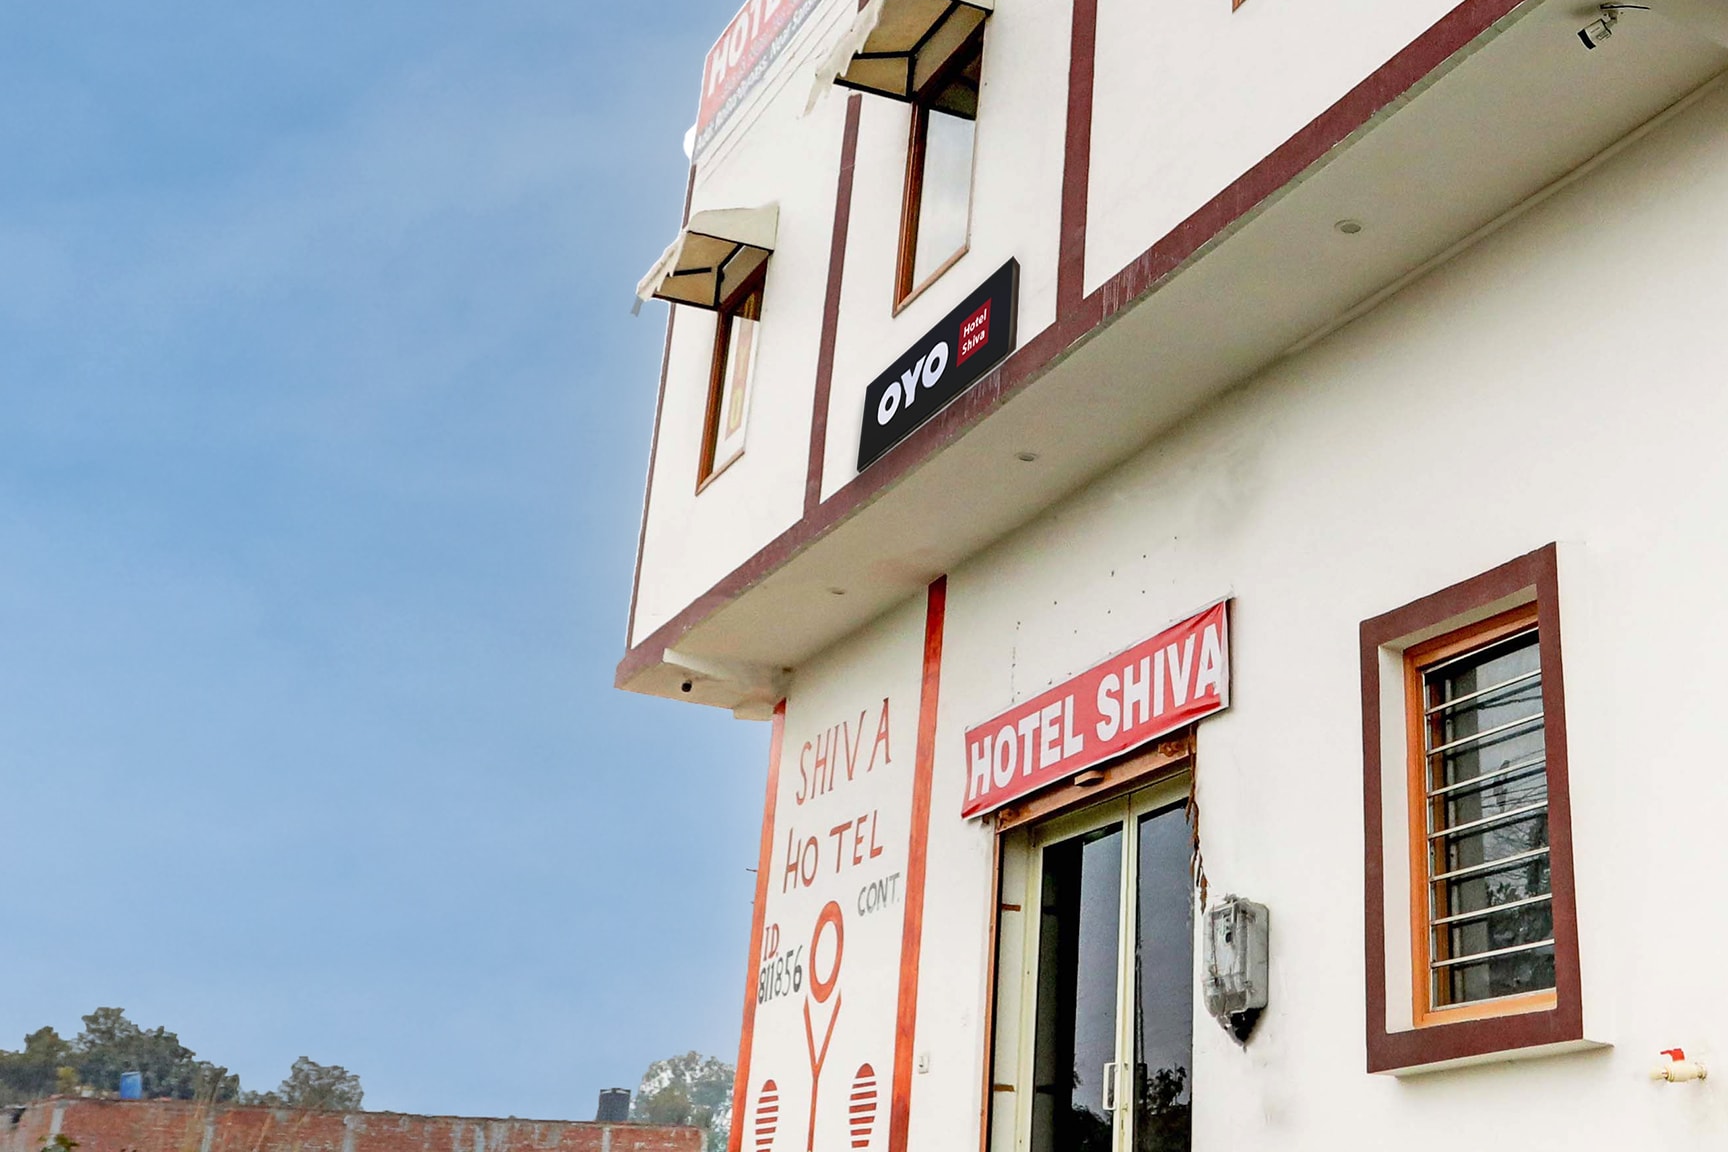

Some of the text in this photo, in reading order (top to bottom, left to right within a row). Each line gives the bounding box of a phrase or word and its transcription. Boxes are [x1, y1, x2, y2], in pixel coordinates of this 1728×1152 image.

[962, 330, 985, 356] Shiva
[963, 308, 987, 338] Hotel
[877, 341, 949, 426] OYO
[796, 697, 892, 806] SHIVA
[968, 623, 1223, 802] HOTEL SHIVA
